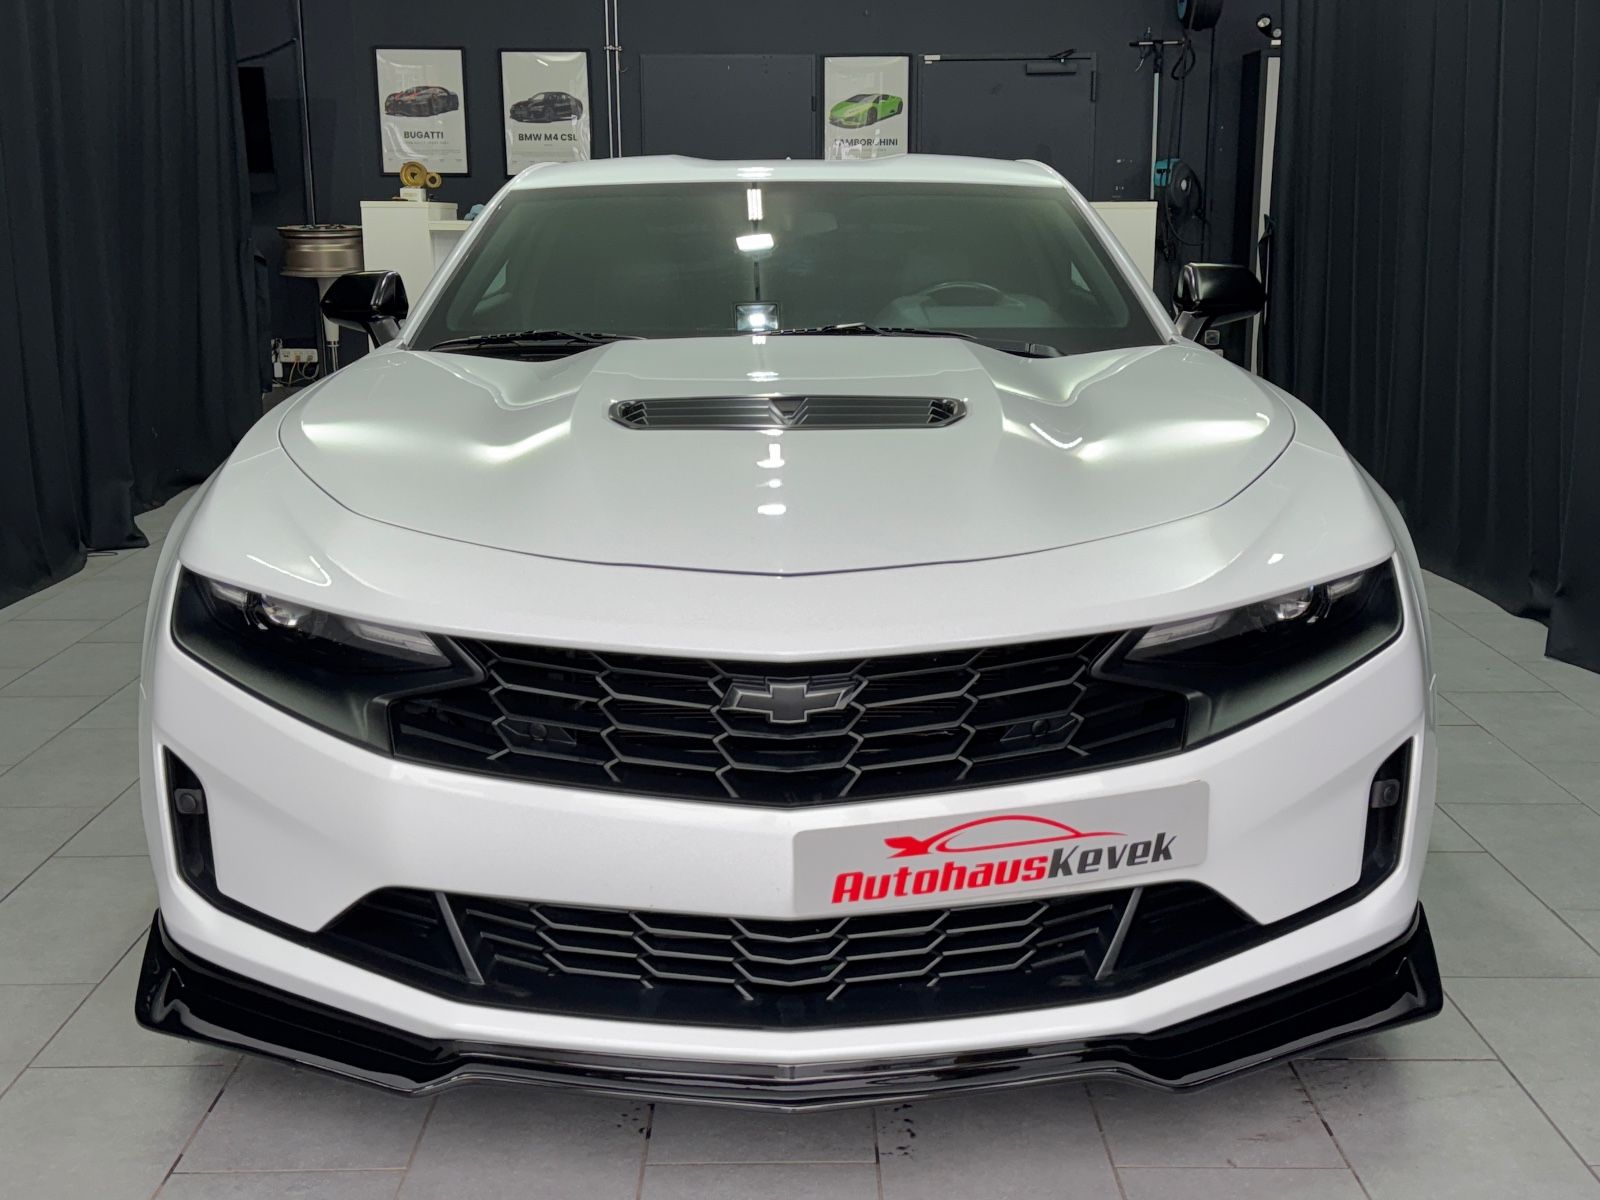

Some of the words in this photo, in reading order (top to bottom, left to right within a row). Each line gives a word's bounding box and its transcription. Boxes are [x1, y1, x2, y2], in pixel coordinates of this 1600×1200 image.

[403, 131, 444, 139] BUGATTI
[518, 133, 542, 141] BMW
[544, 133, 558, 141] M4
[560, 133, 577, 141] CSL
[834, 138, 898, 147] AMBORHINI
